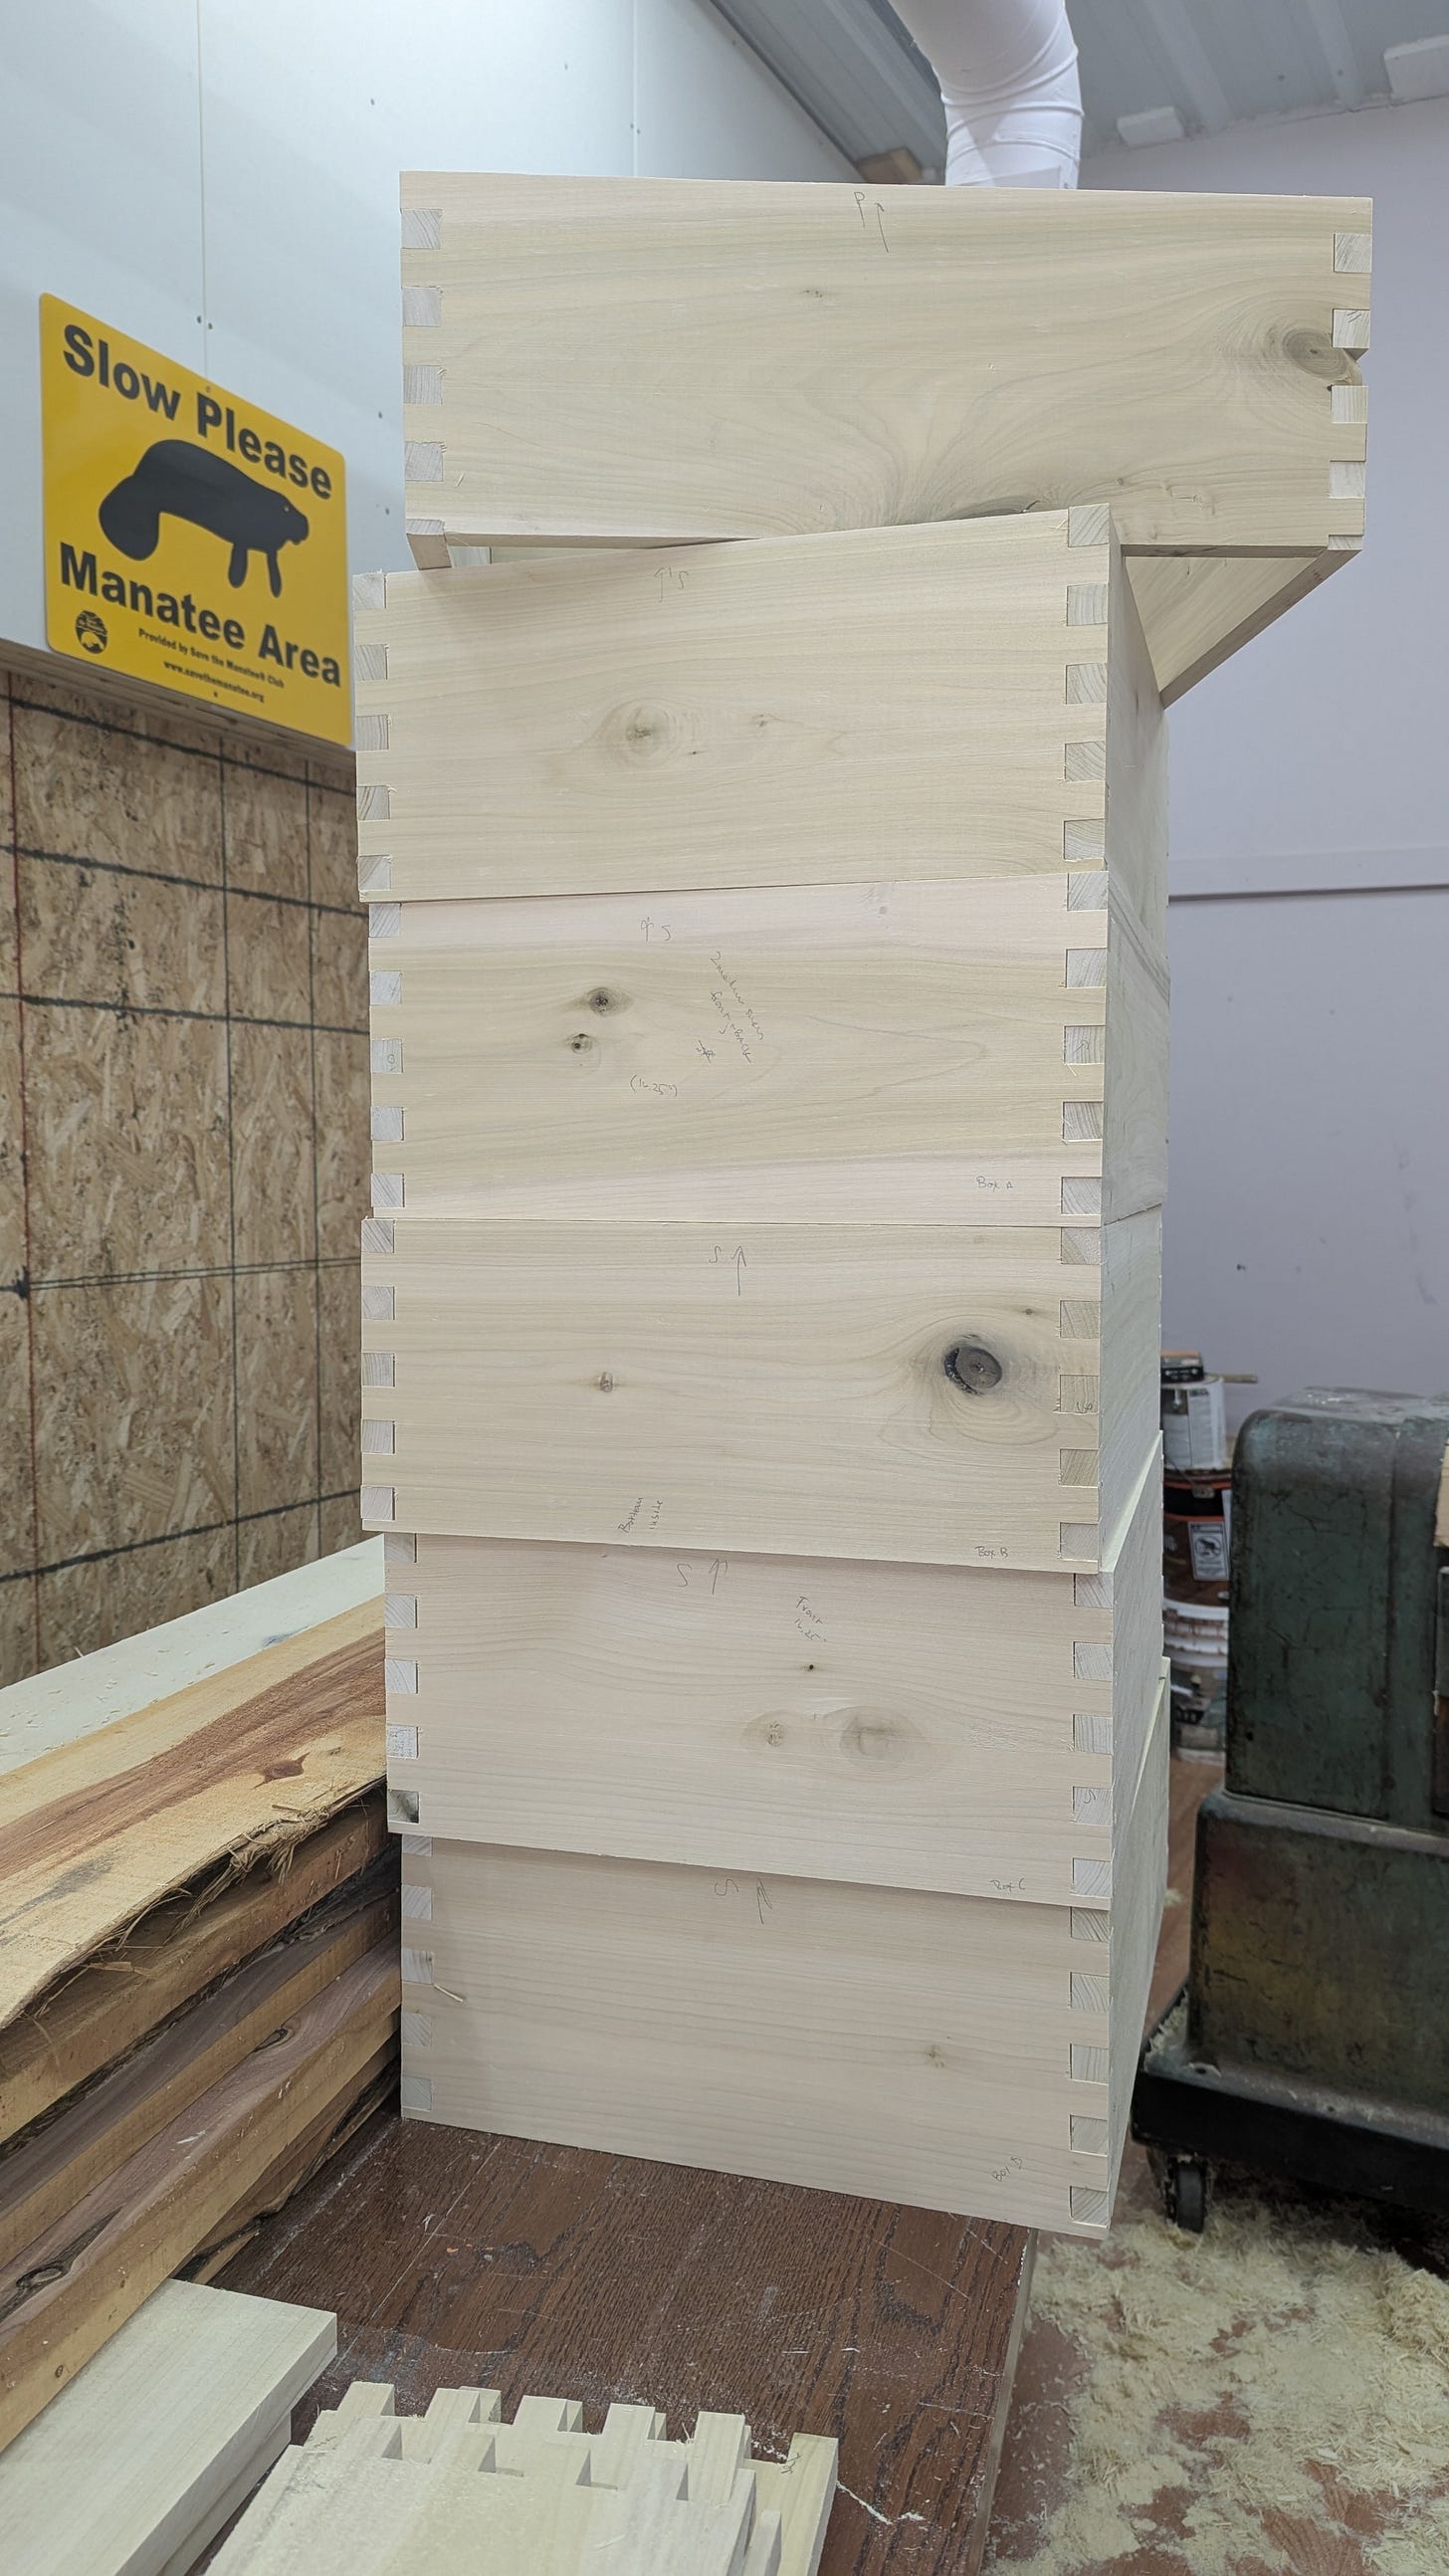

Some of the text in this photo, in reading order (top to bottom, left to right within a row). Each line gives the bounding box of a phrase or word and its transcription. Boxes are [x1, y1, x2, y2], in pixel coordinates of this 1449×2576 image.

[63, 323, 332, 499] Slow Please
[60, 541, 340, 688] Manatee Area
[138, 627, 177, 650] Provided
[178, 642, 188, 655] by
[190, 647, 209, 661] Save
[211, 654, 224, 667] the
[267, 675, 285, 689] Club
[163, 661, 265, 704] www.savethemanatee.org
[976, 1176, 1000, 1192] Box
[974, 1546, 1009, 1559] Box B
[990, 1877, 1026, 1893] Box C
